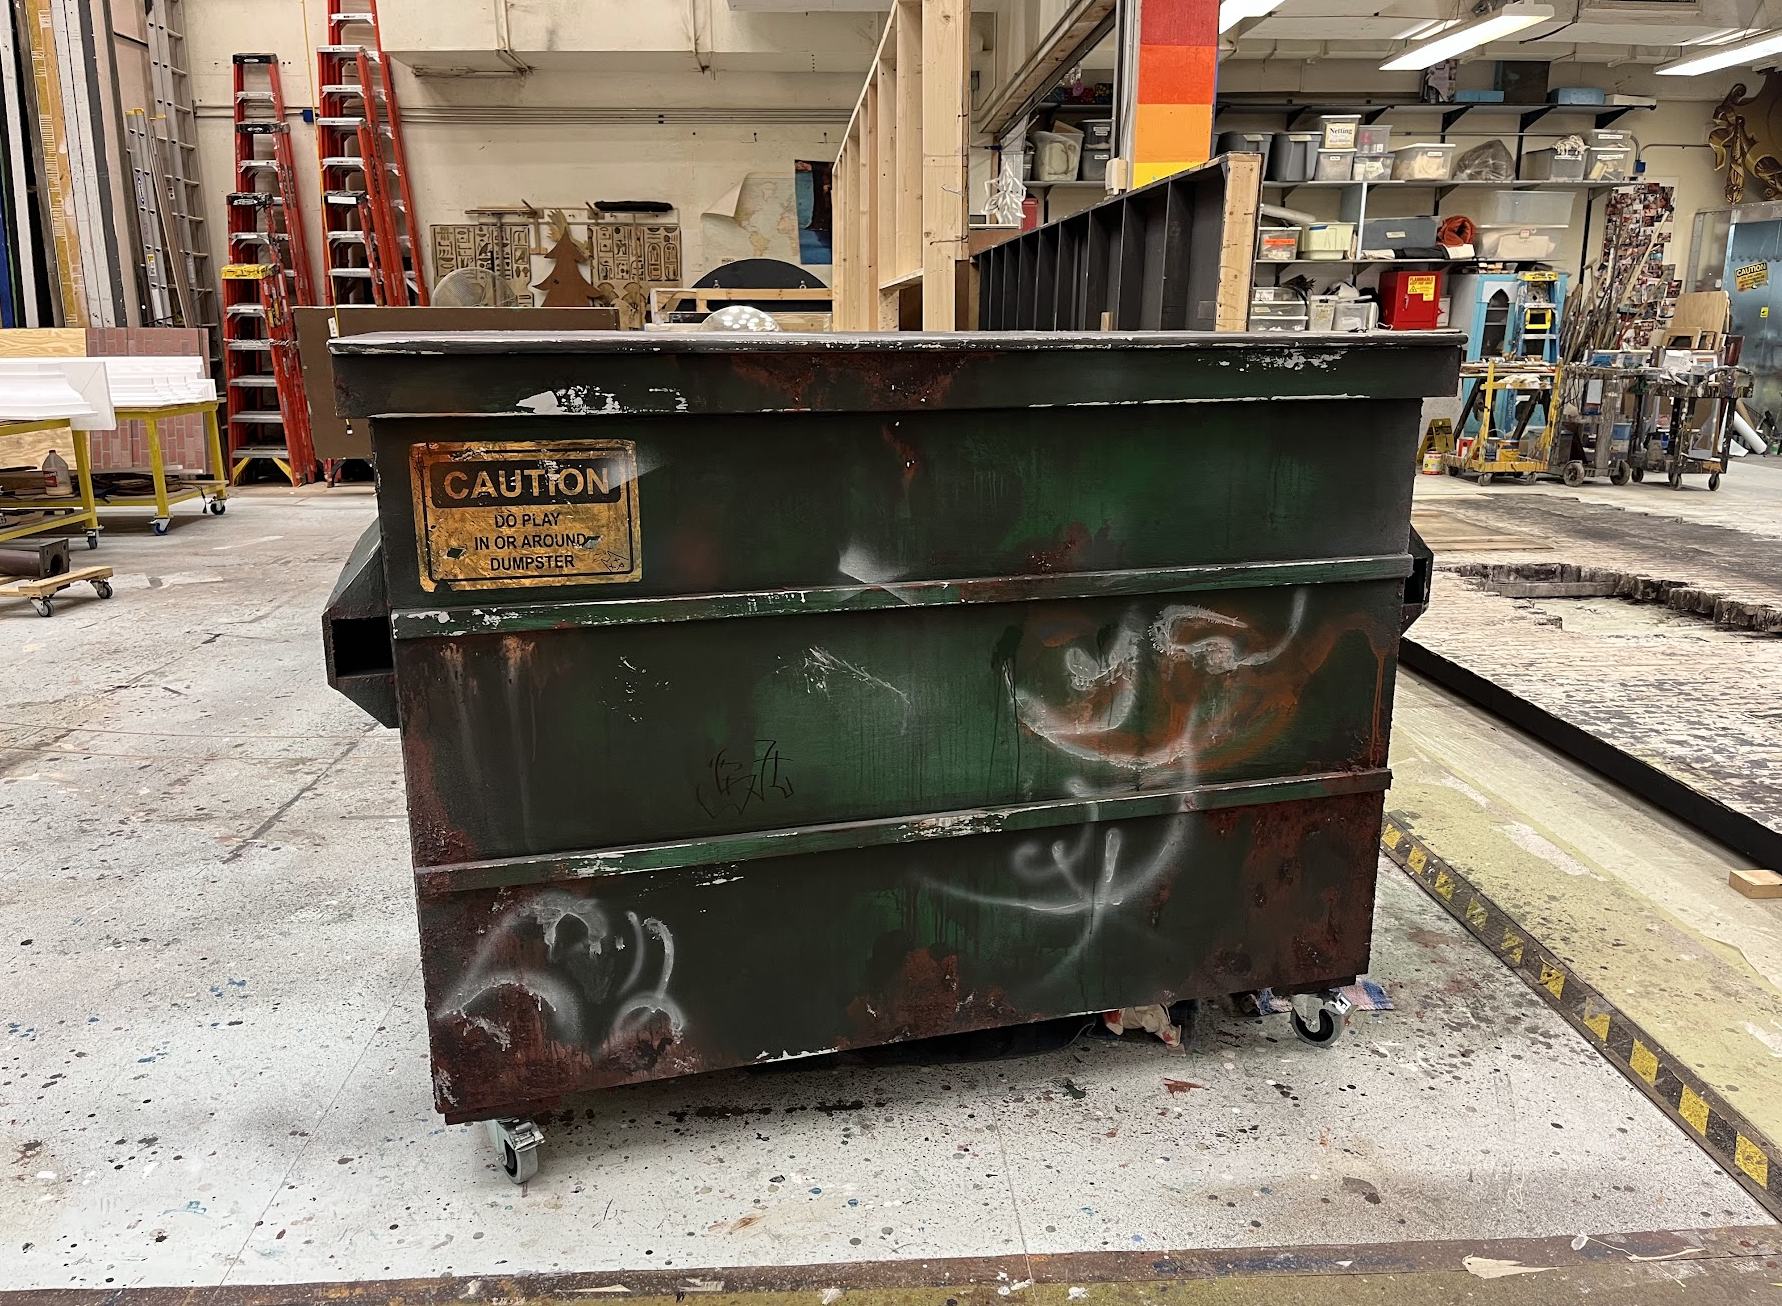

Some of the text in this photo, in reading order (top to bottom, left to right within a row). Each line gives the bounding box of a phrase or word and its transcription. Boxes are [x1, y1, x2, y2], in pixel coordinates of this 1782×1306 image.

[1737, 263, 1766, 276] CAUTION
[444, 467, 610, 500] CAUTION
[494, 512, 561, 528] DO PLAY
[475, 533, 587, 550] IN OR AROUND
[490, 554, 575, 571] DUMPSTER
